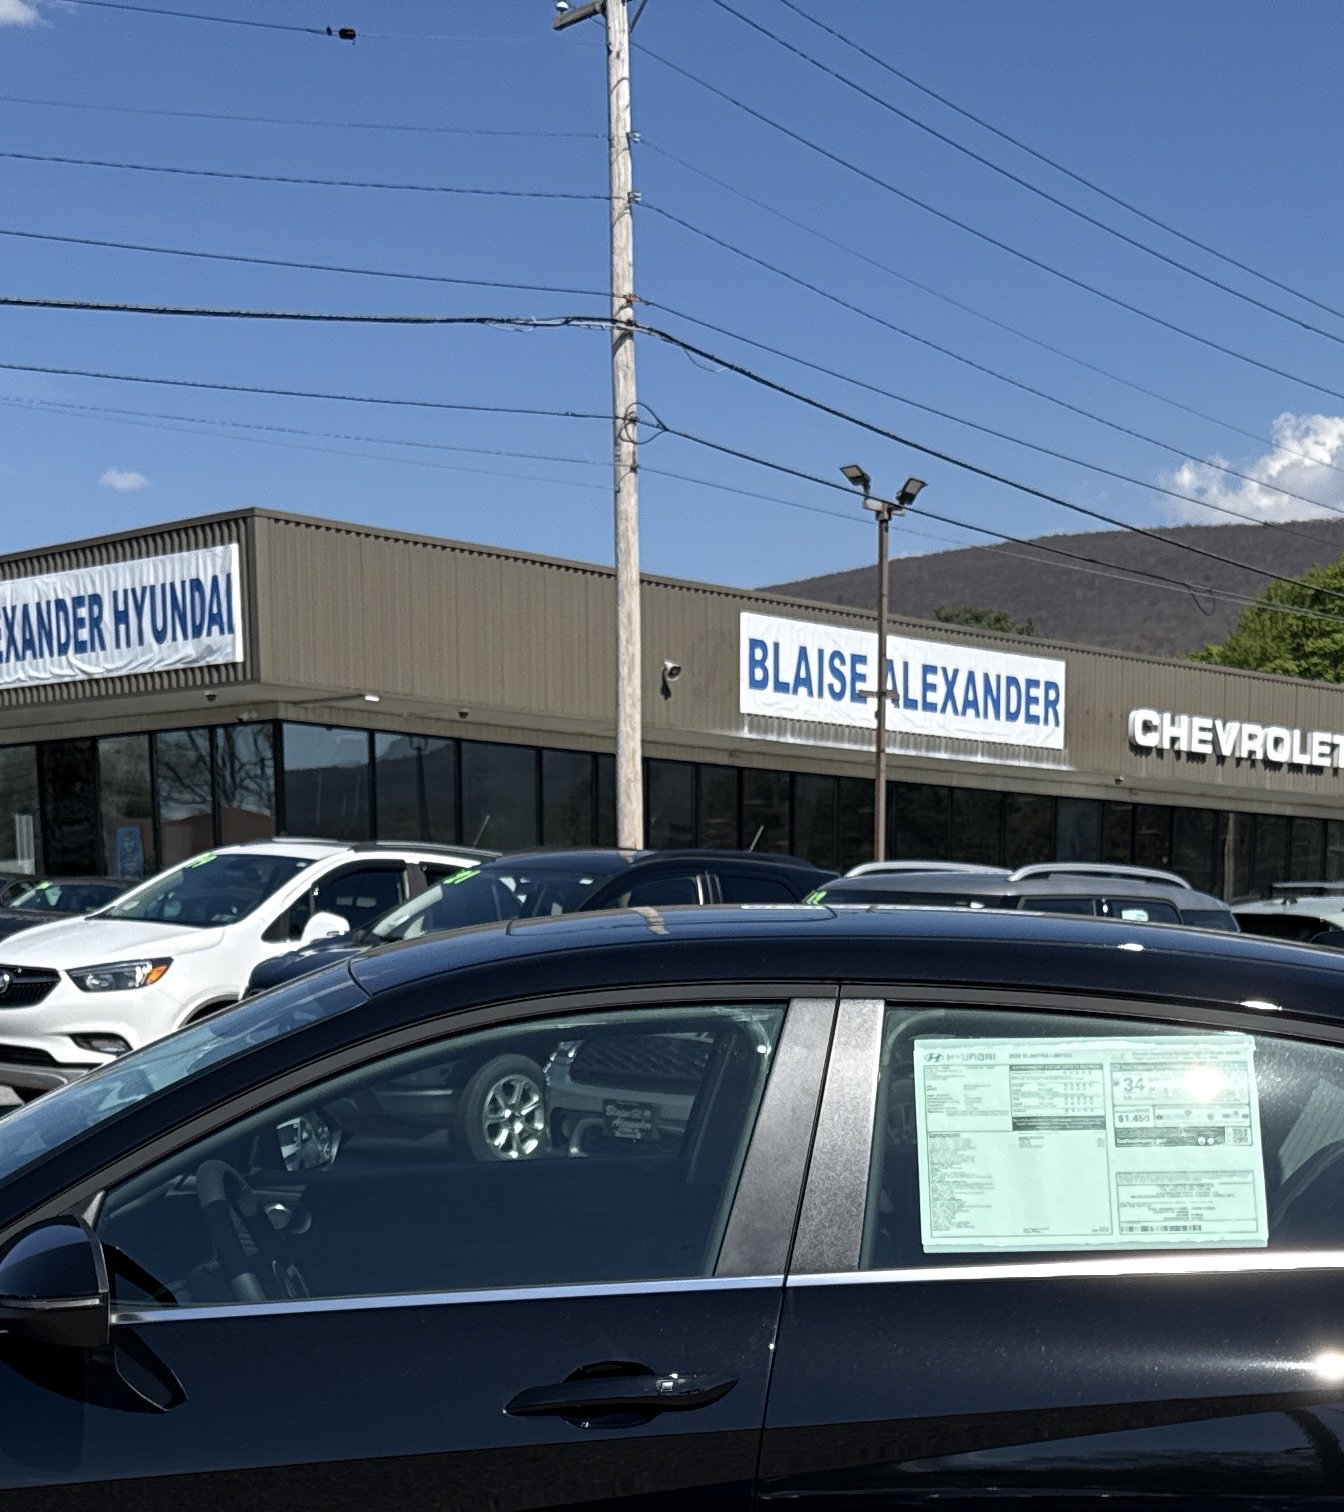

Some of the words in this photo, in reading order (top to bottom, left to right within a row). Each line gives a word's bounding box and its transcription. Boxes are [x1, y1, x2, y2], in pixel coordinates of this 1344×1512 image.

[112, 572, 235, 650] HYUNDAI
[748, 637, 868, 704] BLAISE
[885, 657, 1061, 728] ALEXANDER
[1123, 1076, 1145, 1093] 34
